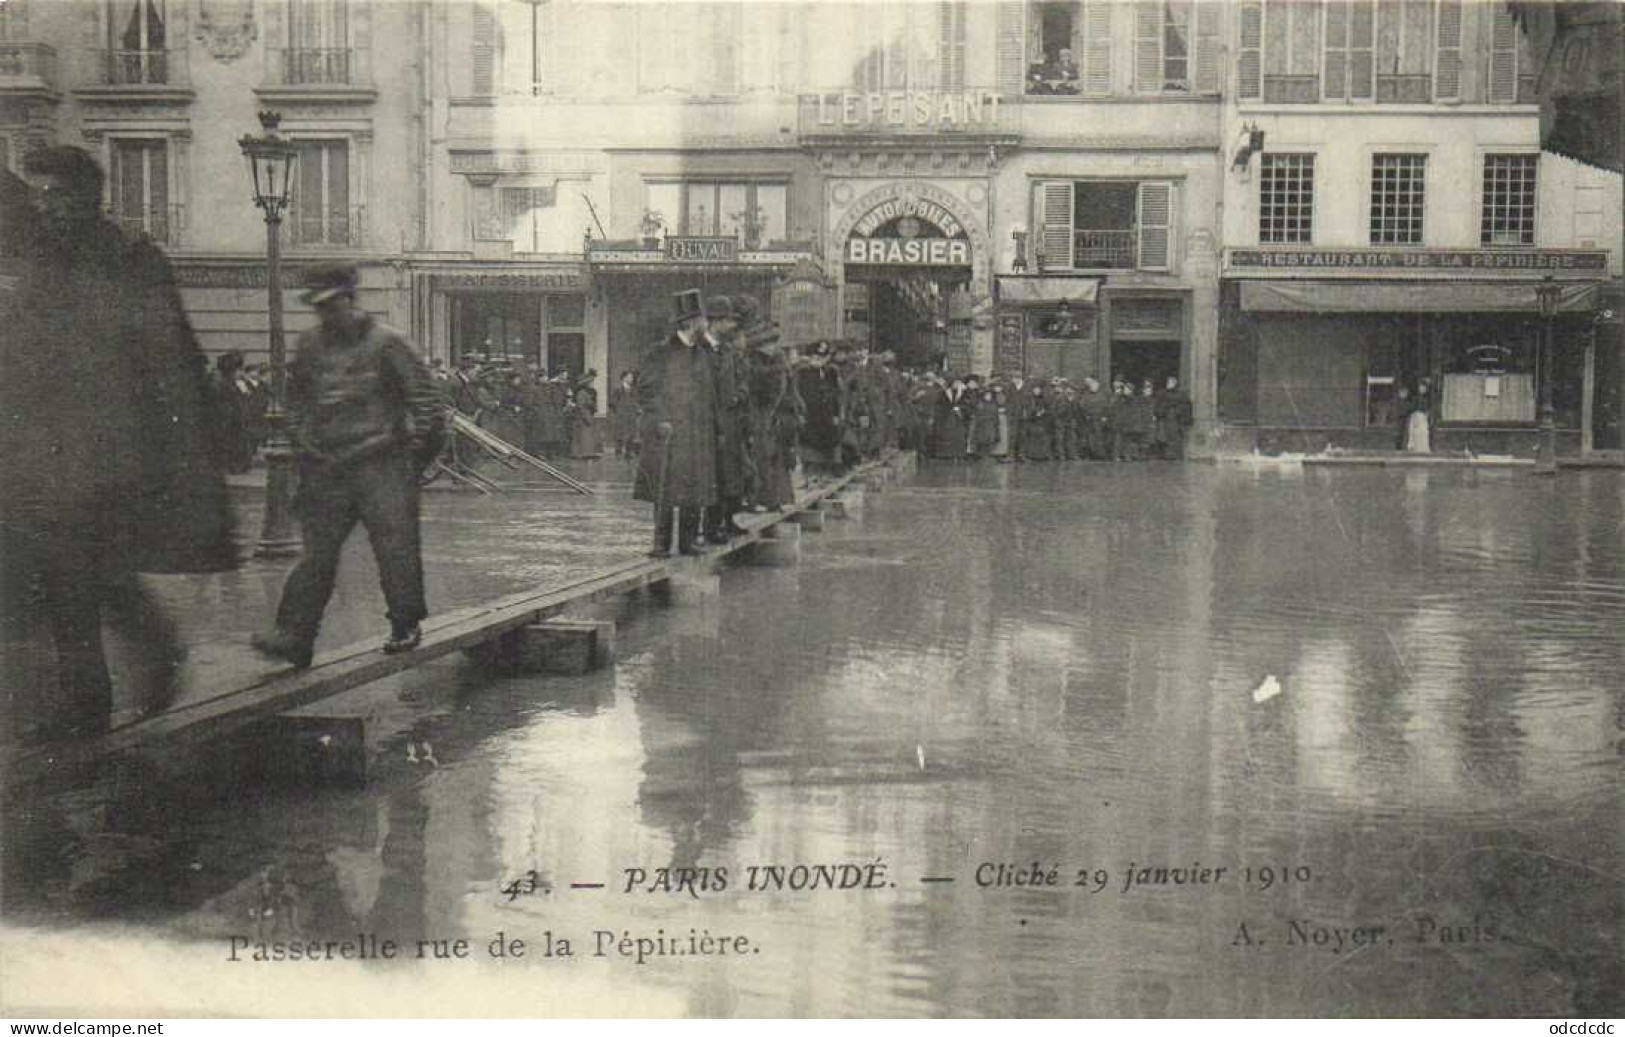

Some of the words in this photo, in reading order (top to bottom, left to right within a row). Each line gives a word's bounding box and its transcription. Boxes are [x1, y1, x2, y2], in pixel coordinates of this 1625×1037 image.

[850, 240, 968, 263] BRASIER
[1261, 253, 1392, 267] RESTAURANT
[1403, 253, 1429, 267] DE
[1441, 253, 1464, 267] LA
